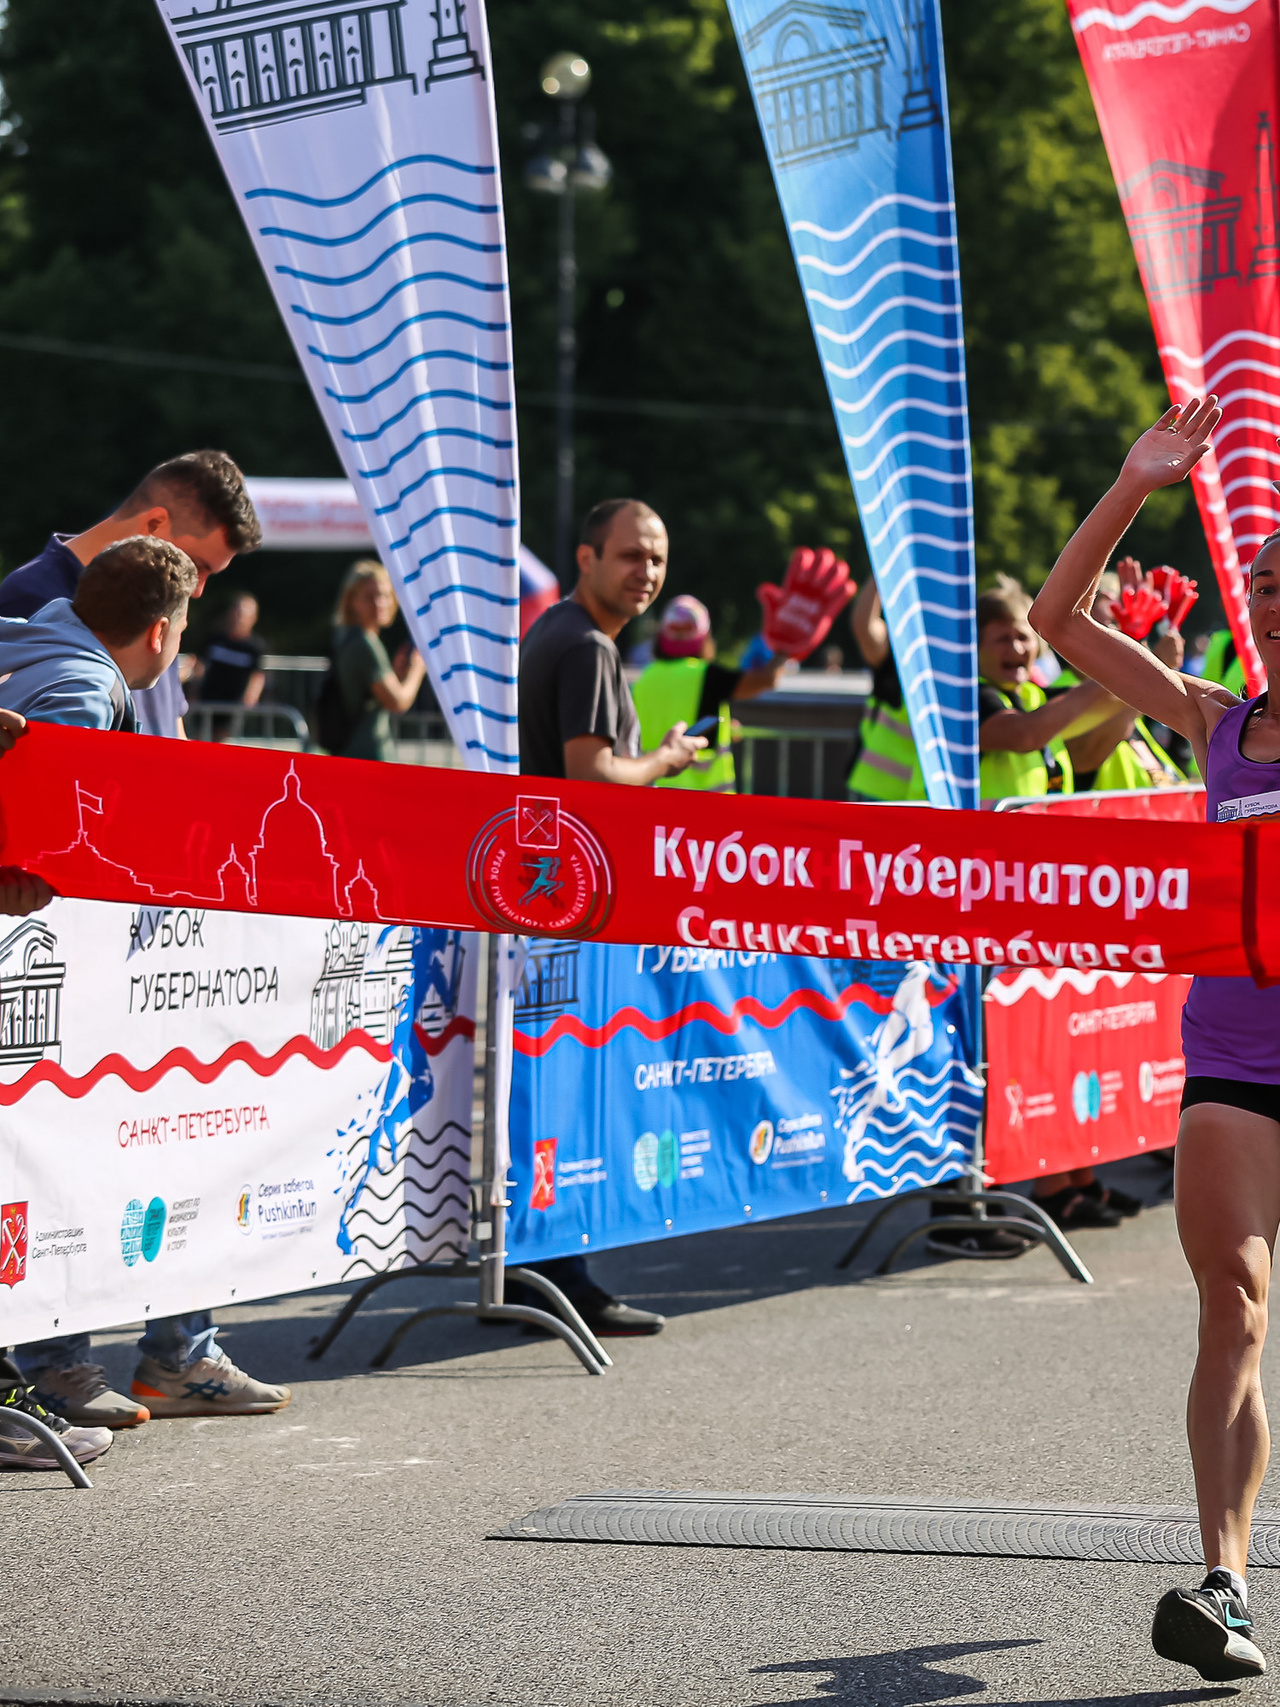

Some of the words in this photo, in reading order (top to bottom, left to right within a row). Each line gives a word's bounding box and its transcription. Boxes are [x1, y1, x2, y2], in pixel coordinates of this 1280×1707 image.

[653, 824, 815, 892] Кубок
[838, 839, 1189, 920] Губернатора
[129, 909, 206, 952] КУБОК
[676, 906, 1166, 969] Санкт-Петербурга
[128, 966, 279, 1014] ГУБЕРНАТОРА
[117, 1104, 270, 1148] САНКТ-ПЕТЕРБУРГА
[258, 1198, 317, 1224] PushkinRun
